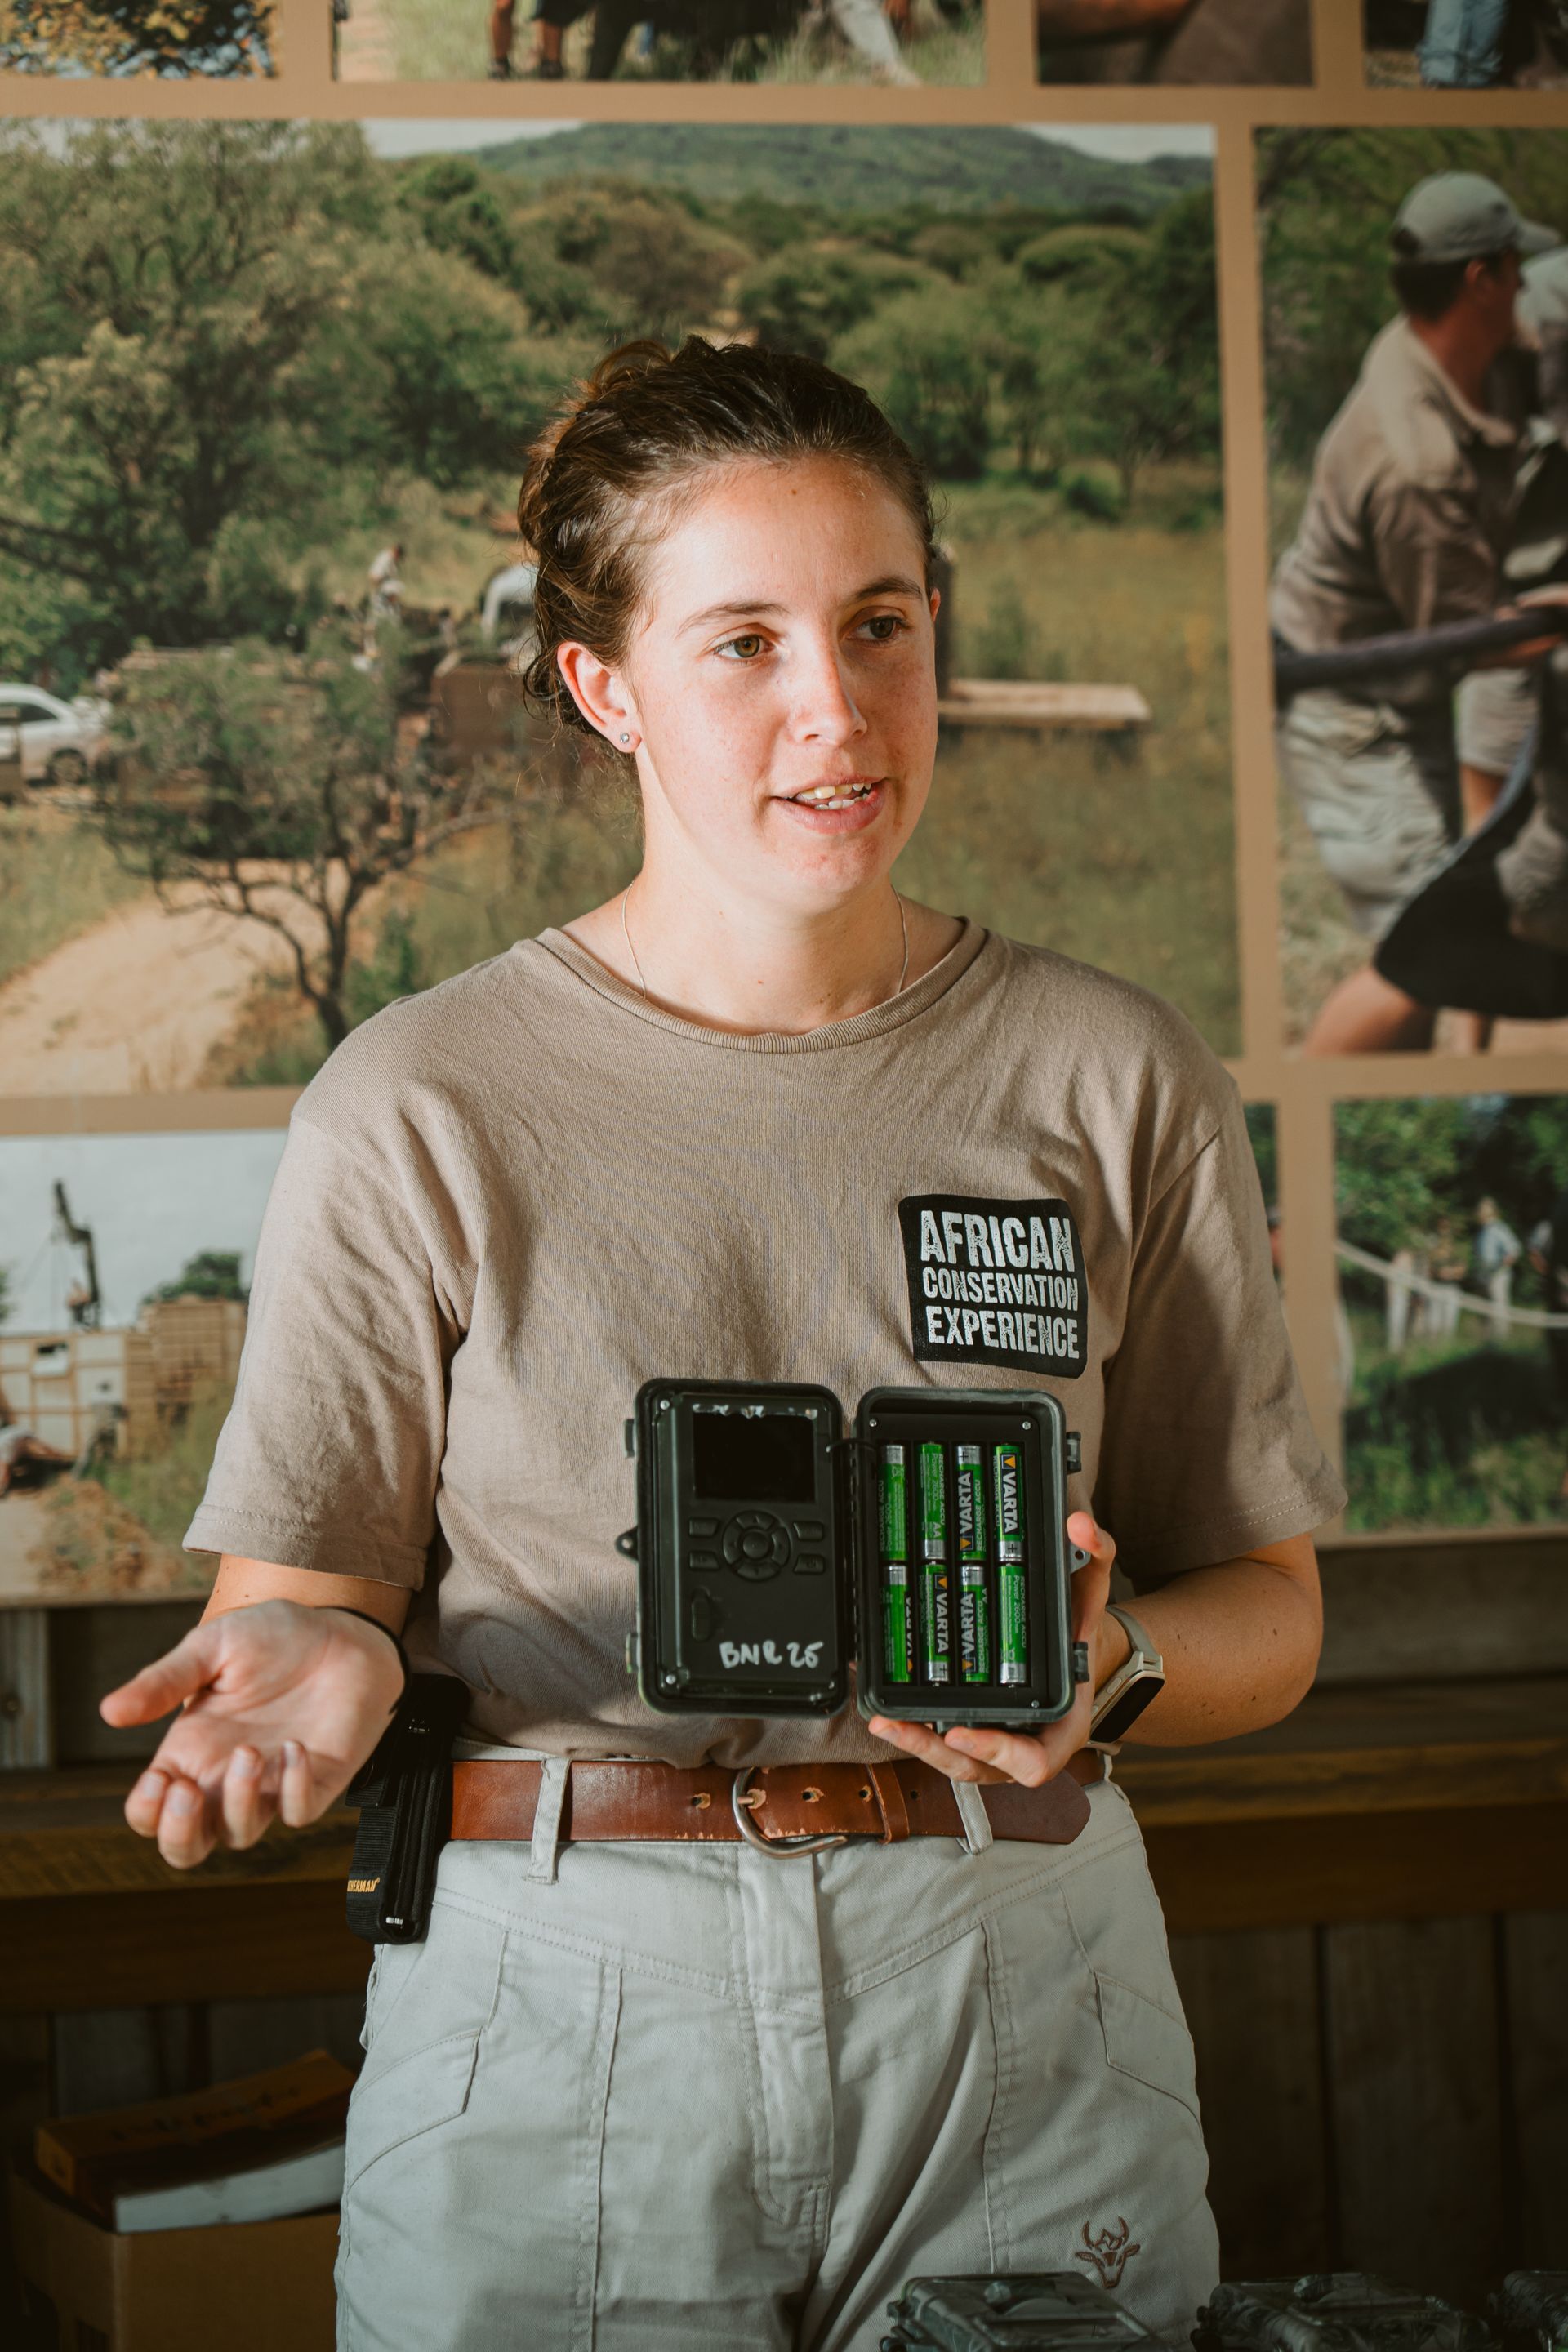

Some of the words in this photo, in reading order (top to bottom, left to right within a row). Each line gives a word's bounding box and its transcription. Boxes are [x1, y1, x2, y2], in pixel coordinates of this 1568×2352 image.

[920, 1209, 1075, 1272] AFRICAN
[922, 1266, 1078, 1311] CONSERVATION
[925, 1305, 1080, 1359] EXPERIENCE
[933, 1521, 941, 1538] AA
[957, 1472, 973, 1534] VARTA
[1002, 1471, 1018, 1534] VARTA
[936, 1592, 949, 1653] VARTA
[960, 1592, 975, 1655] VARTA
